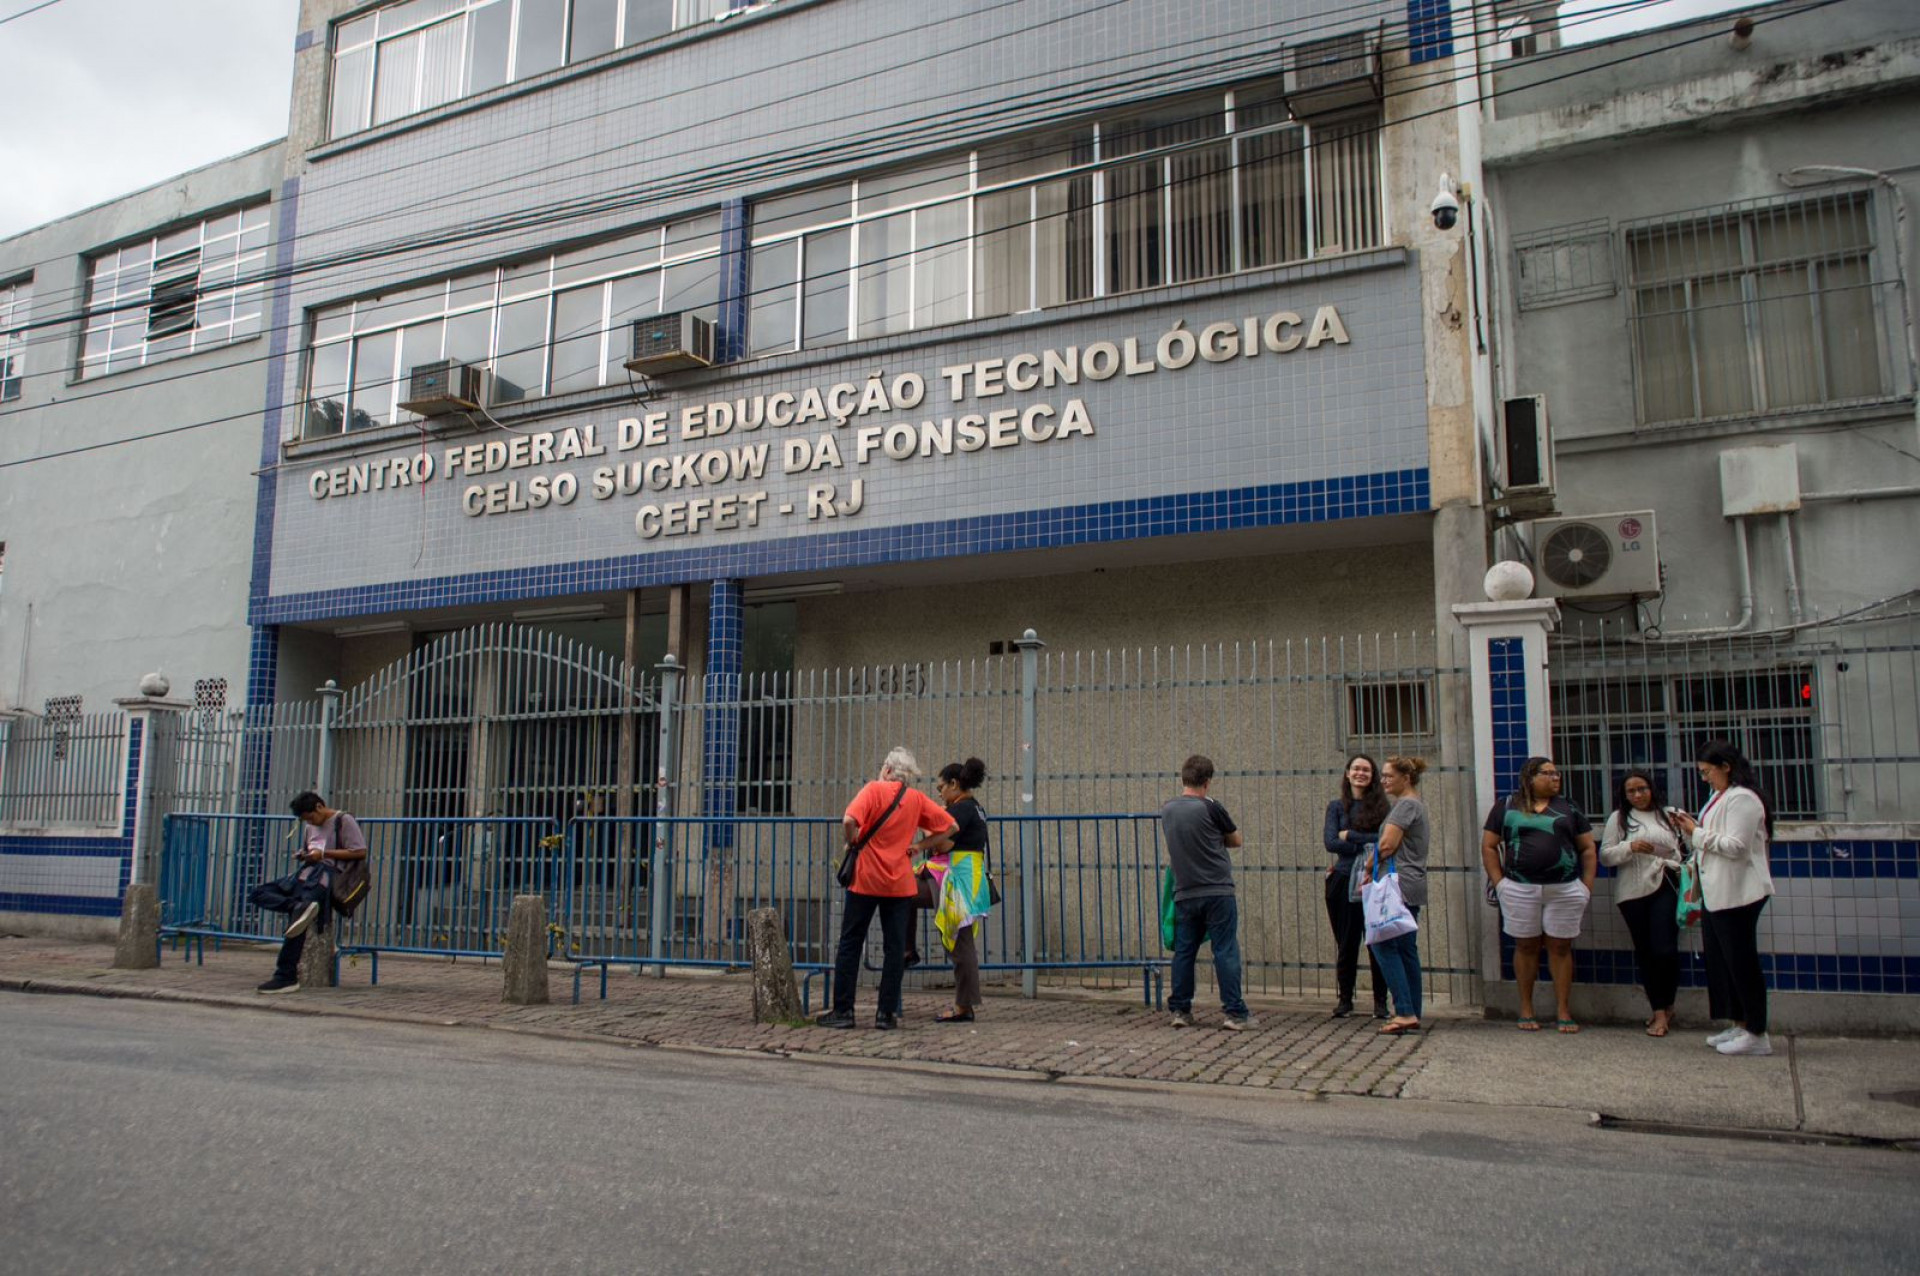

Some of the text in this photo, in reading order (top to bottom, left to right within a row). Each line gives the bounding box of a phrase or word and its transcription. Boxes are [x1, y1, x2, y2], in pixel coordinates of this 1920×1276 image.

[309, 305, 1351, 500] CENTRO FEDERAL DE EDUCAÇÃO TECNOLÓGICA
[463, 399, 1095, 517] CELSO SUCKOW DA FONSECA
[635, 491, 767, 540] CEFET
[807, 479, 864, 520] RJ
[1622, 541, 1640, 552] LG
